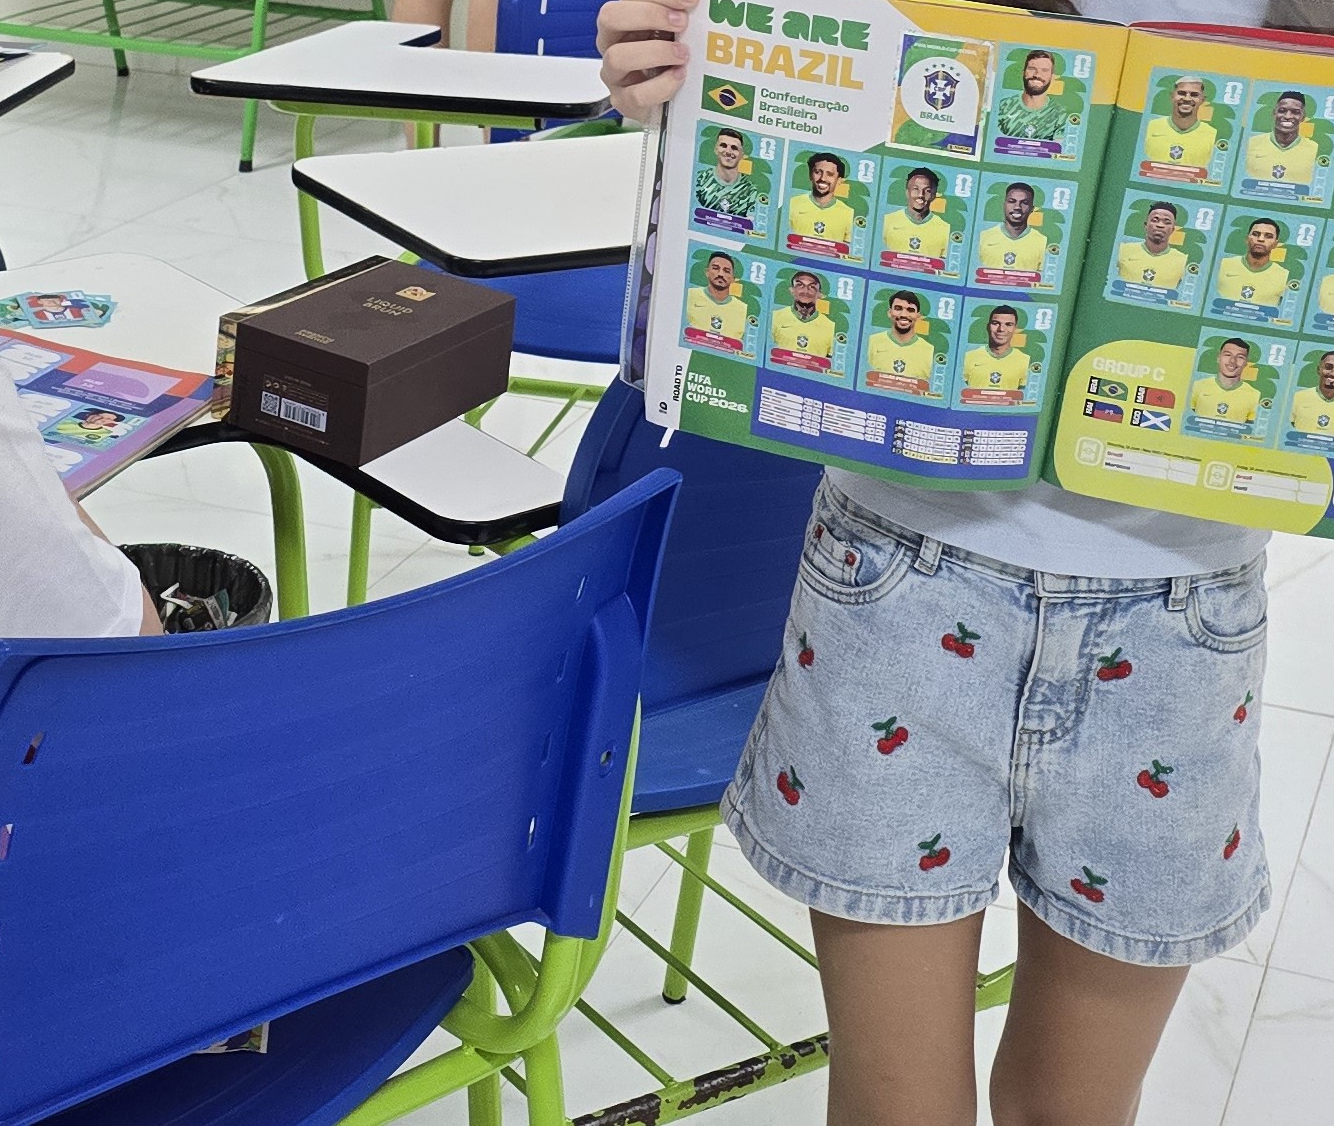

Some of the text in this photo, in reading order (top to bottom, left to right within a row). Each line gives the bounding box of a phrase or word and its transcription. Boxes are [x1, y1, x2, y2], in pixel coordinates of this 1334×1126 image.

[782, 10, 871, 51] ARE
[706, 31, 864, 90] BRAZIL
[760, 88, 849, 112] Confederação
[759, 101, 817, 121] Brasileira
[920, 111, 955, 123] BRASIL
[758, 114, 823, 135] de Futebol
[367, 297, 413, 313] LIQUID
[688, 372, 712, 386] FIFA
[1092, 356, 1166, 382] GROUP C
[687, 382, 727, 398] WORLD
[686, 392, 748, 413] CUP 2026
